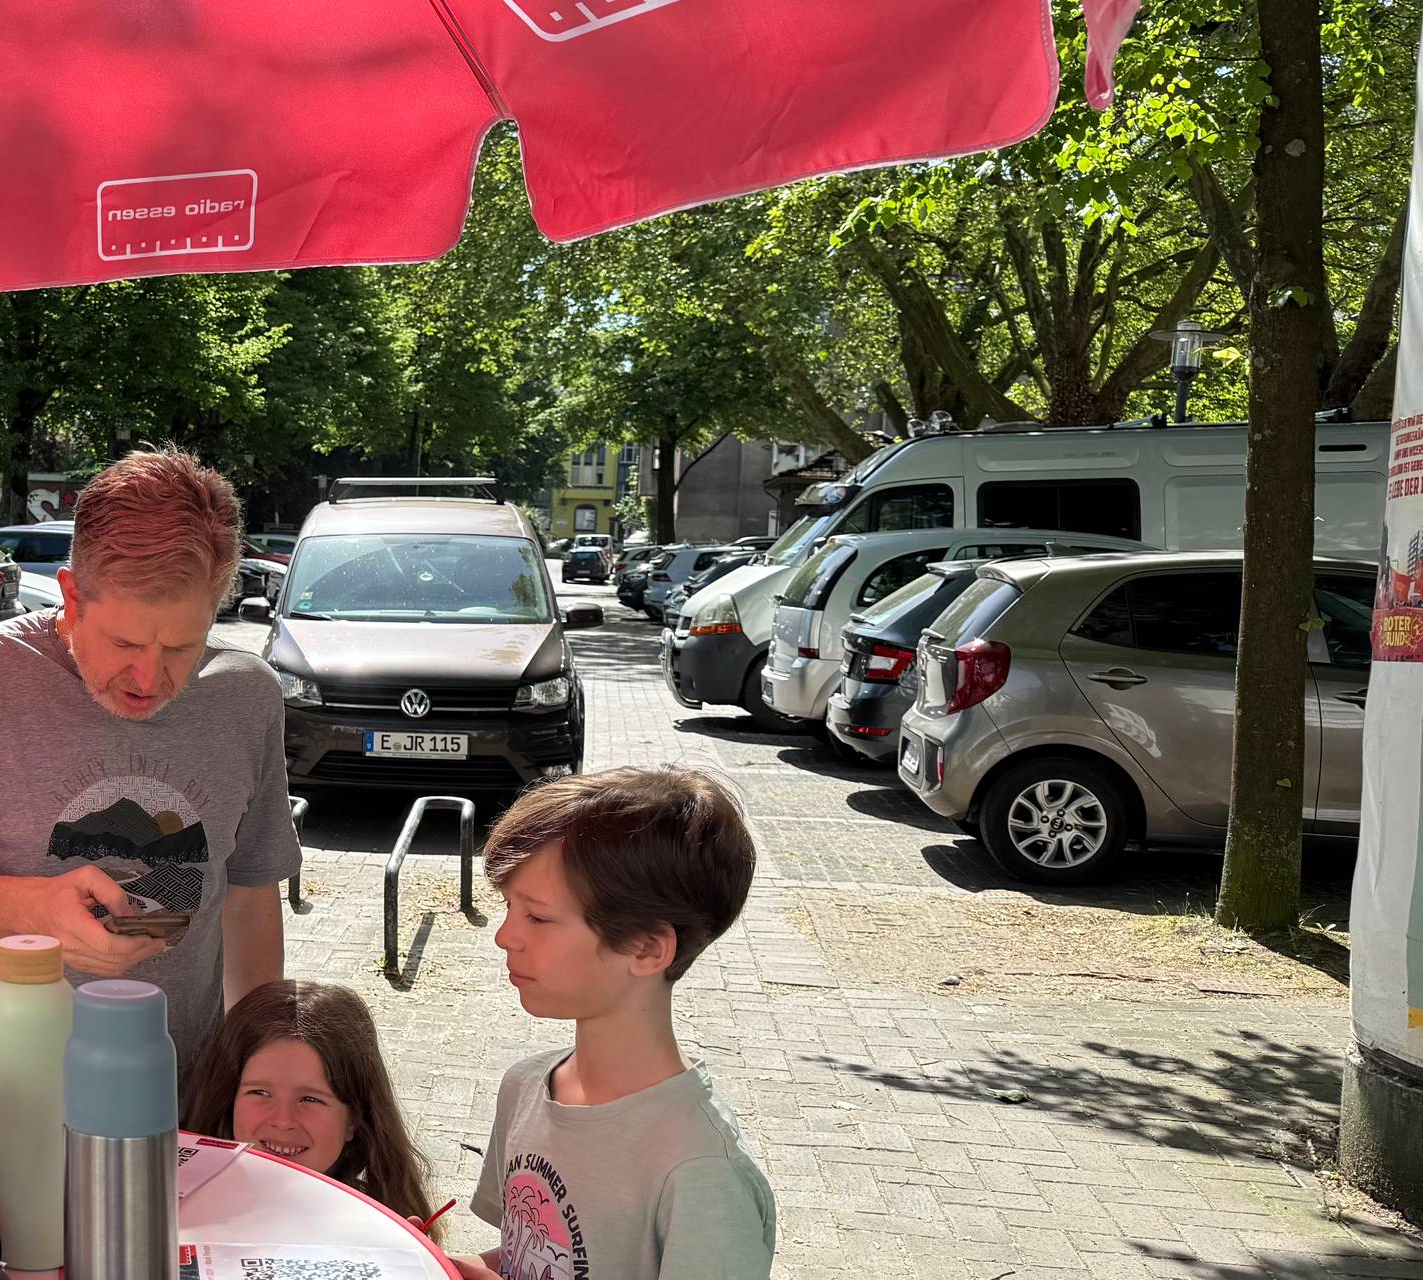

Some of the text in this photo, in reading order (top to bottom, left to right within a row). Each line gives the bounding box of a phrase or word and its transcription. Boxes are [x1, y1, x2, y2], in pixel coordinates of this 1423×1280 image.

[1383, 615, 1411, 631] ROTER
[381, 734, 461, 752] E JR 115
[524, 1153, 568, 1204] SUMMER
[562, 1203, 590, 1280] SURFIN
